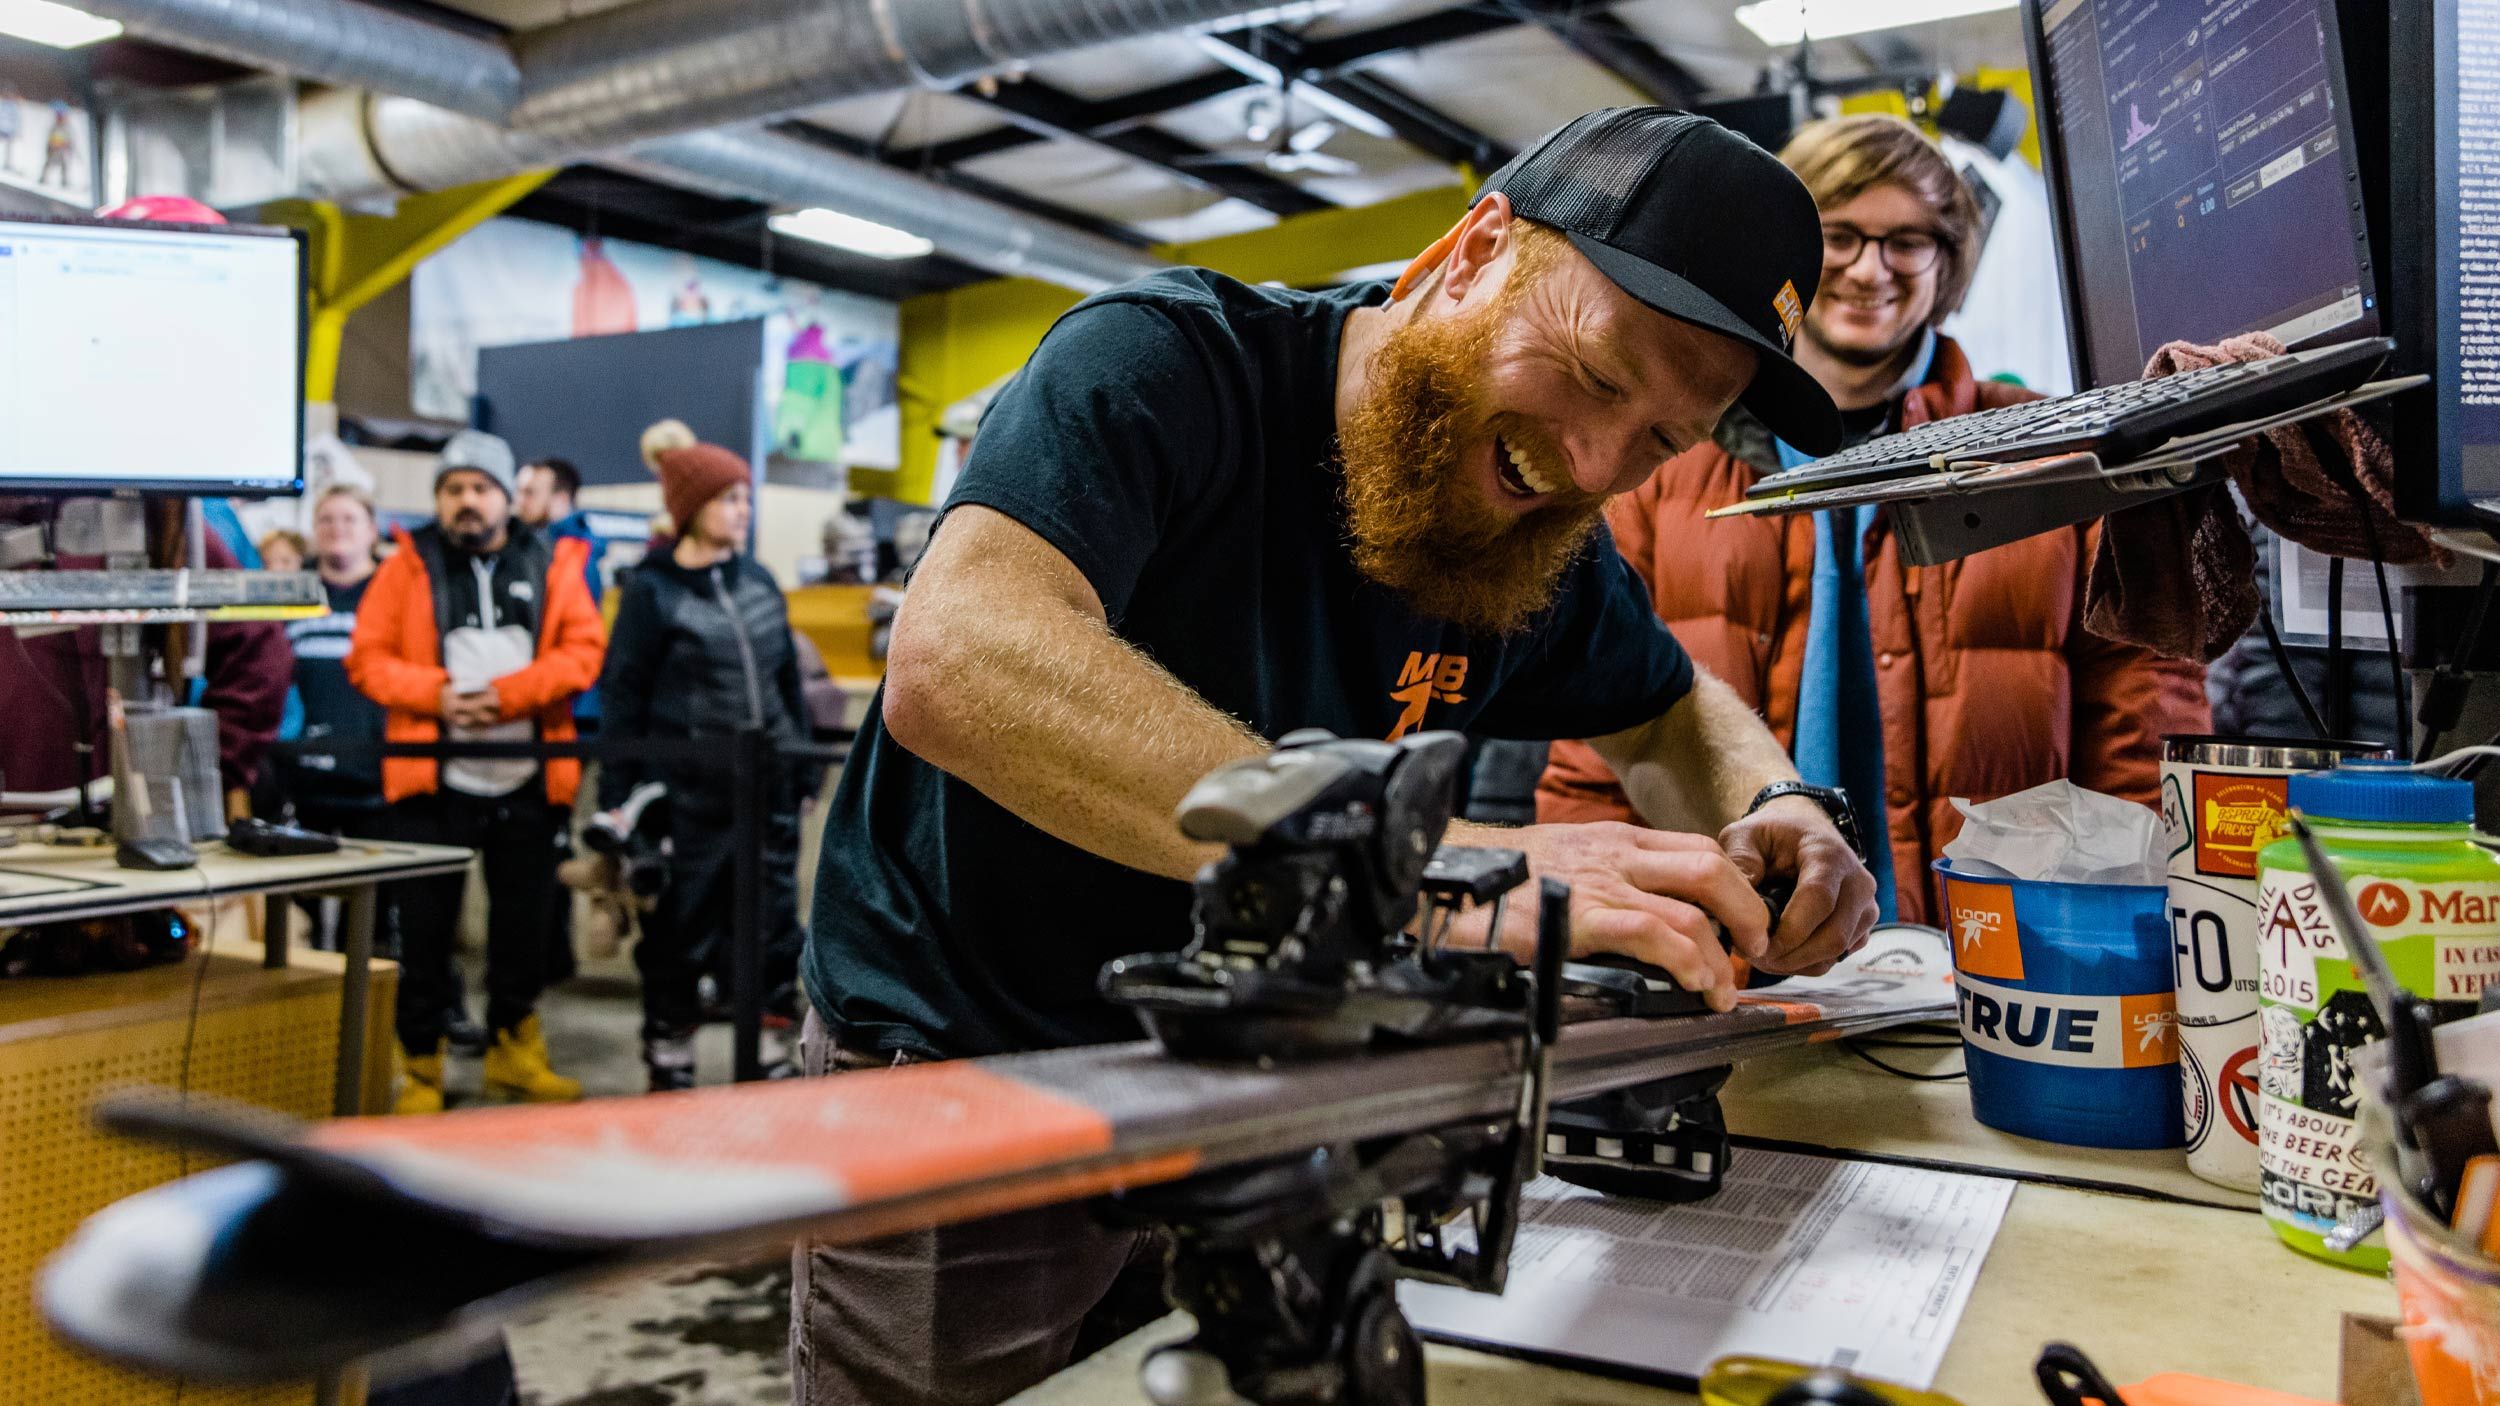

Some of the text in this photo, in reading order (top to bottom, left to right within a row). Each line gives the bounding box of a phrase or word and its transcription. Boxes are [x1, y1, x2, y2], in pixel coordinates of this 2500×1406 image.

[1396, 650, 1469, 692] MB
[2217, 821, 2255, 837] PACKS
[2218, 808, 2269, 827] OSPREY
[1955, 907, 2001, 924] LOON
[2293, 882, 2335, 949] DAYS
[2262, 968, 2314, 1003] 2015
[1956, 982, 2099, 1053] TRUE
[2263, 1102, 2353, 1138] IT'S ABOUT
[2261, 1125, 2342, 1163] THE BEER
[2281, 1158, 2312, 1181] THE
